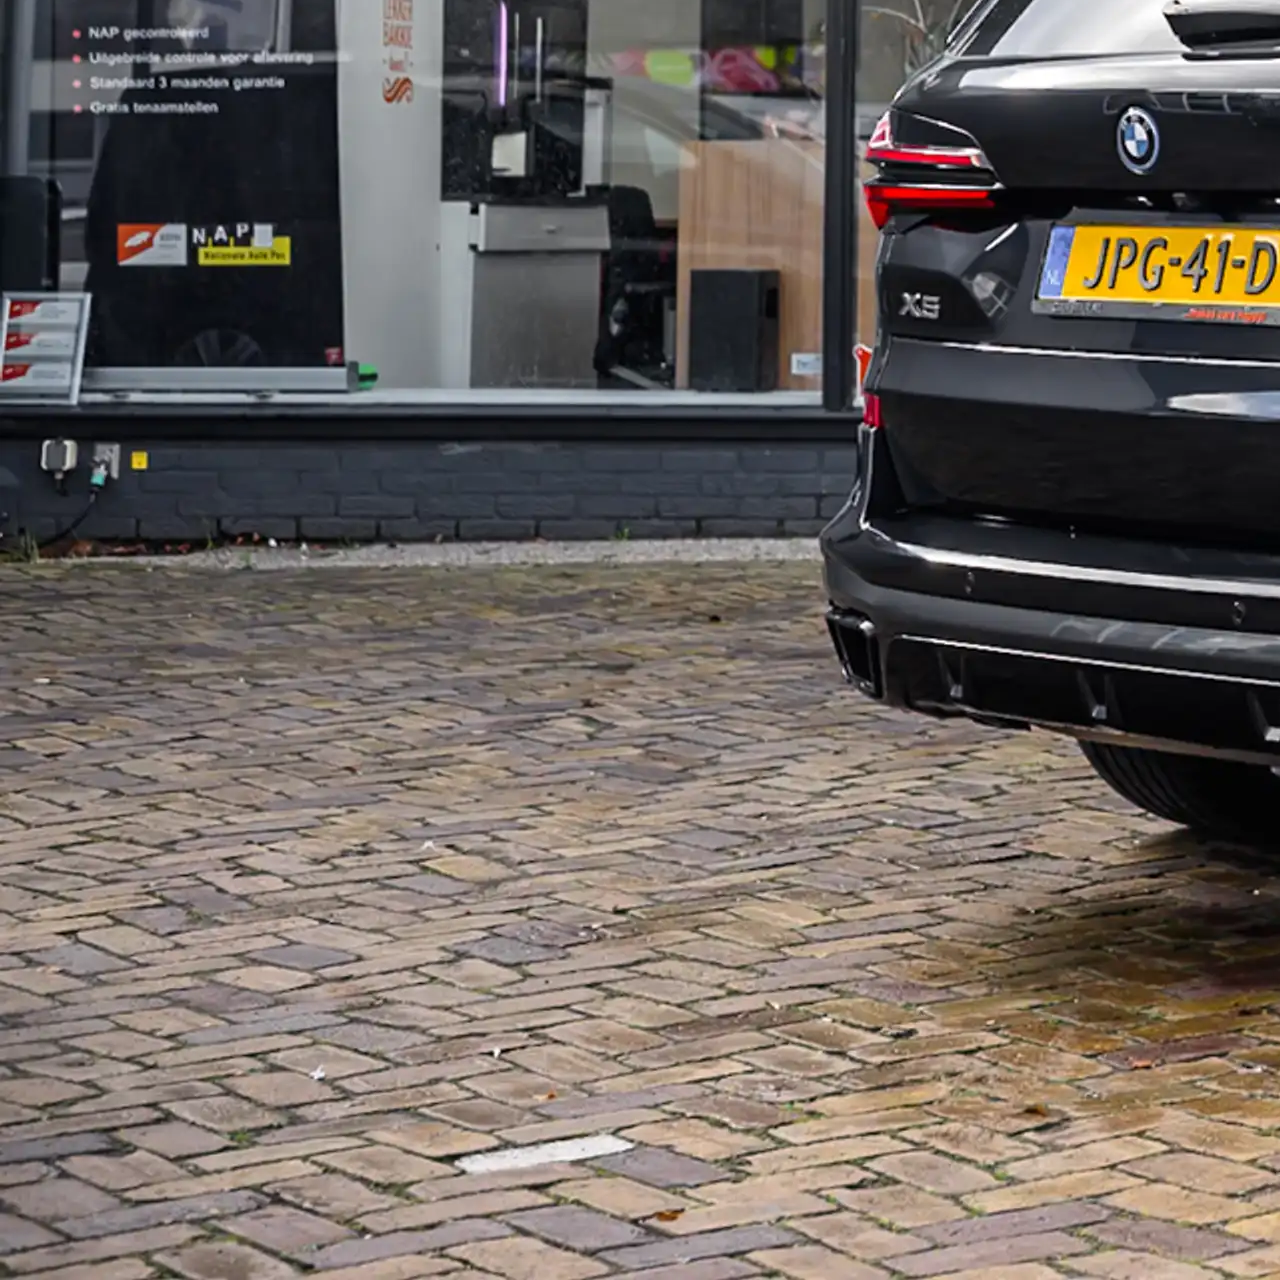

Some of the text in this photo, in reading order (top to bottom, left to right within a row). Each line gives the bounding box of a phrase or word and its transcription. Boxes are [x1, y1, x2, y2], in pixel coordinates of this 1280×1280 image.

[88, 26, 210, 42] NAP gecontroleerd
[165, 50, 215, 64] controle
[220, 51, 249, 64] voor
[89, 76, 286, 92] Standaard 3 maanden garantie
[89, 100, 219, 114] Gratis tenaamstellen
[1081, 237, 1278, 295] JPG-41-D
[898, 292, 941, 320] X5
